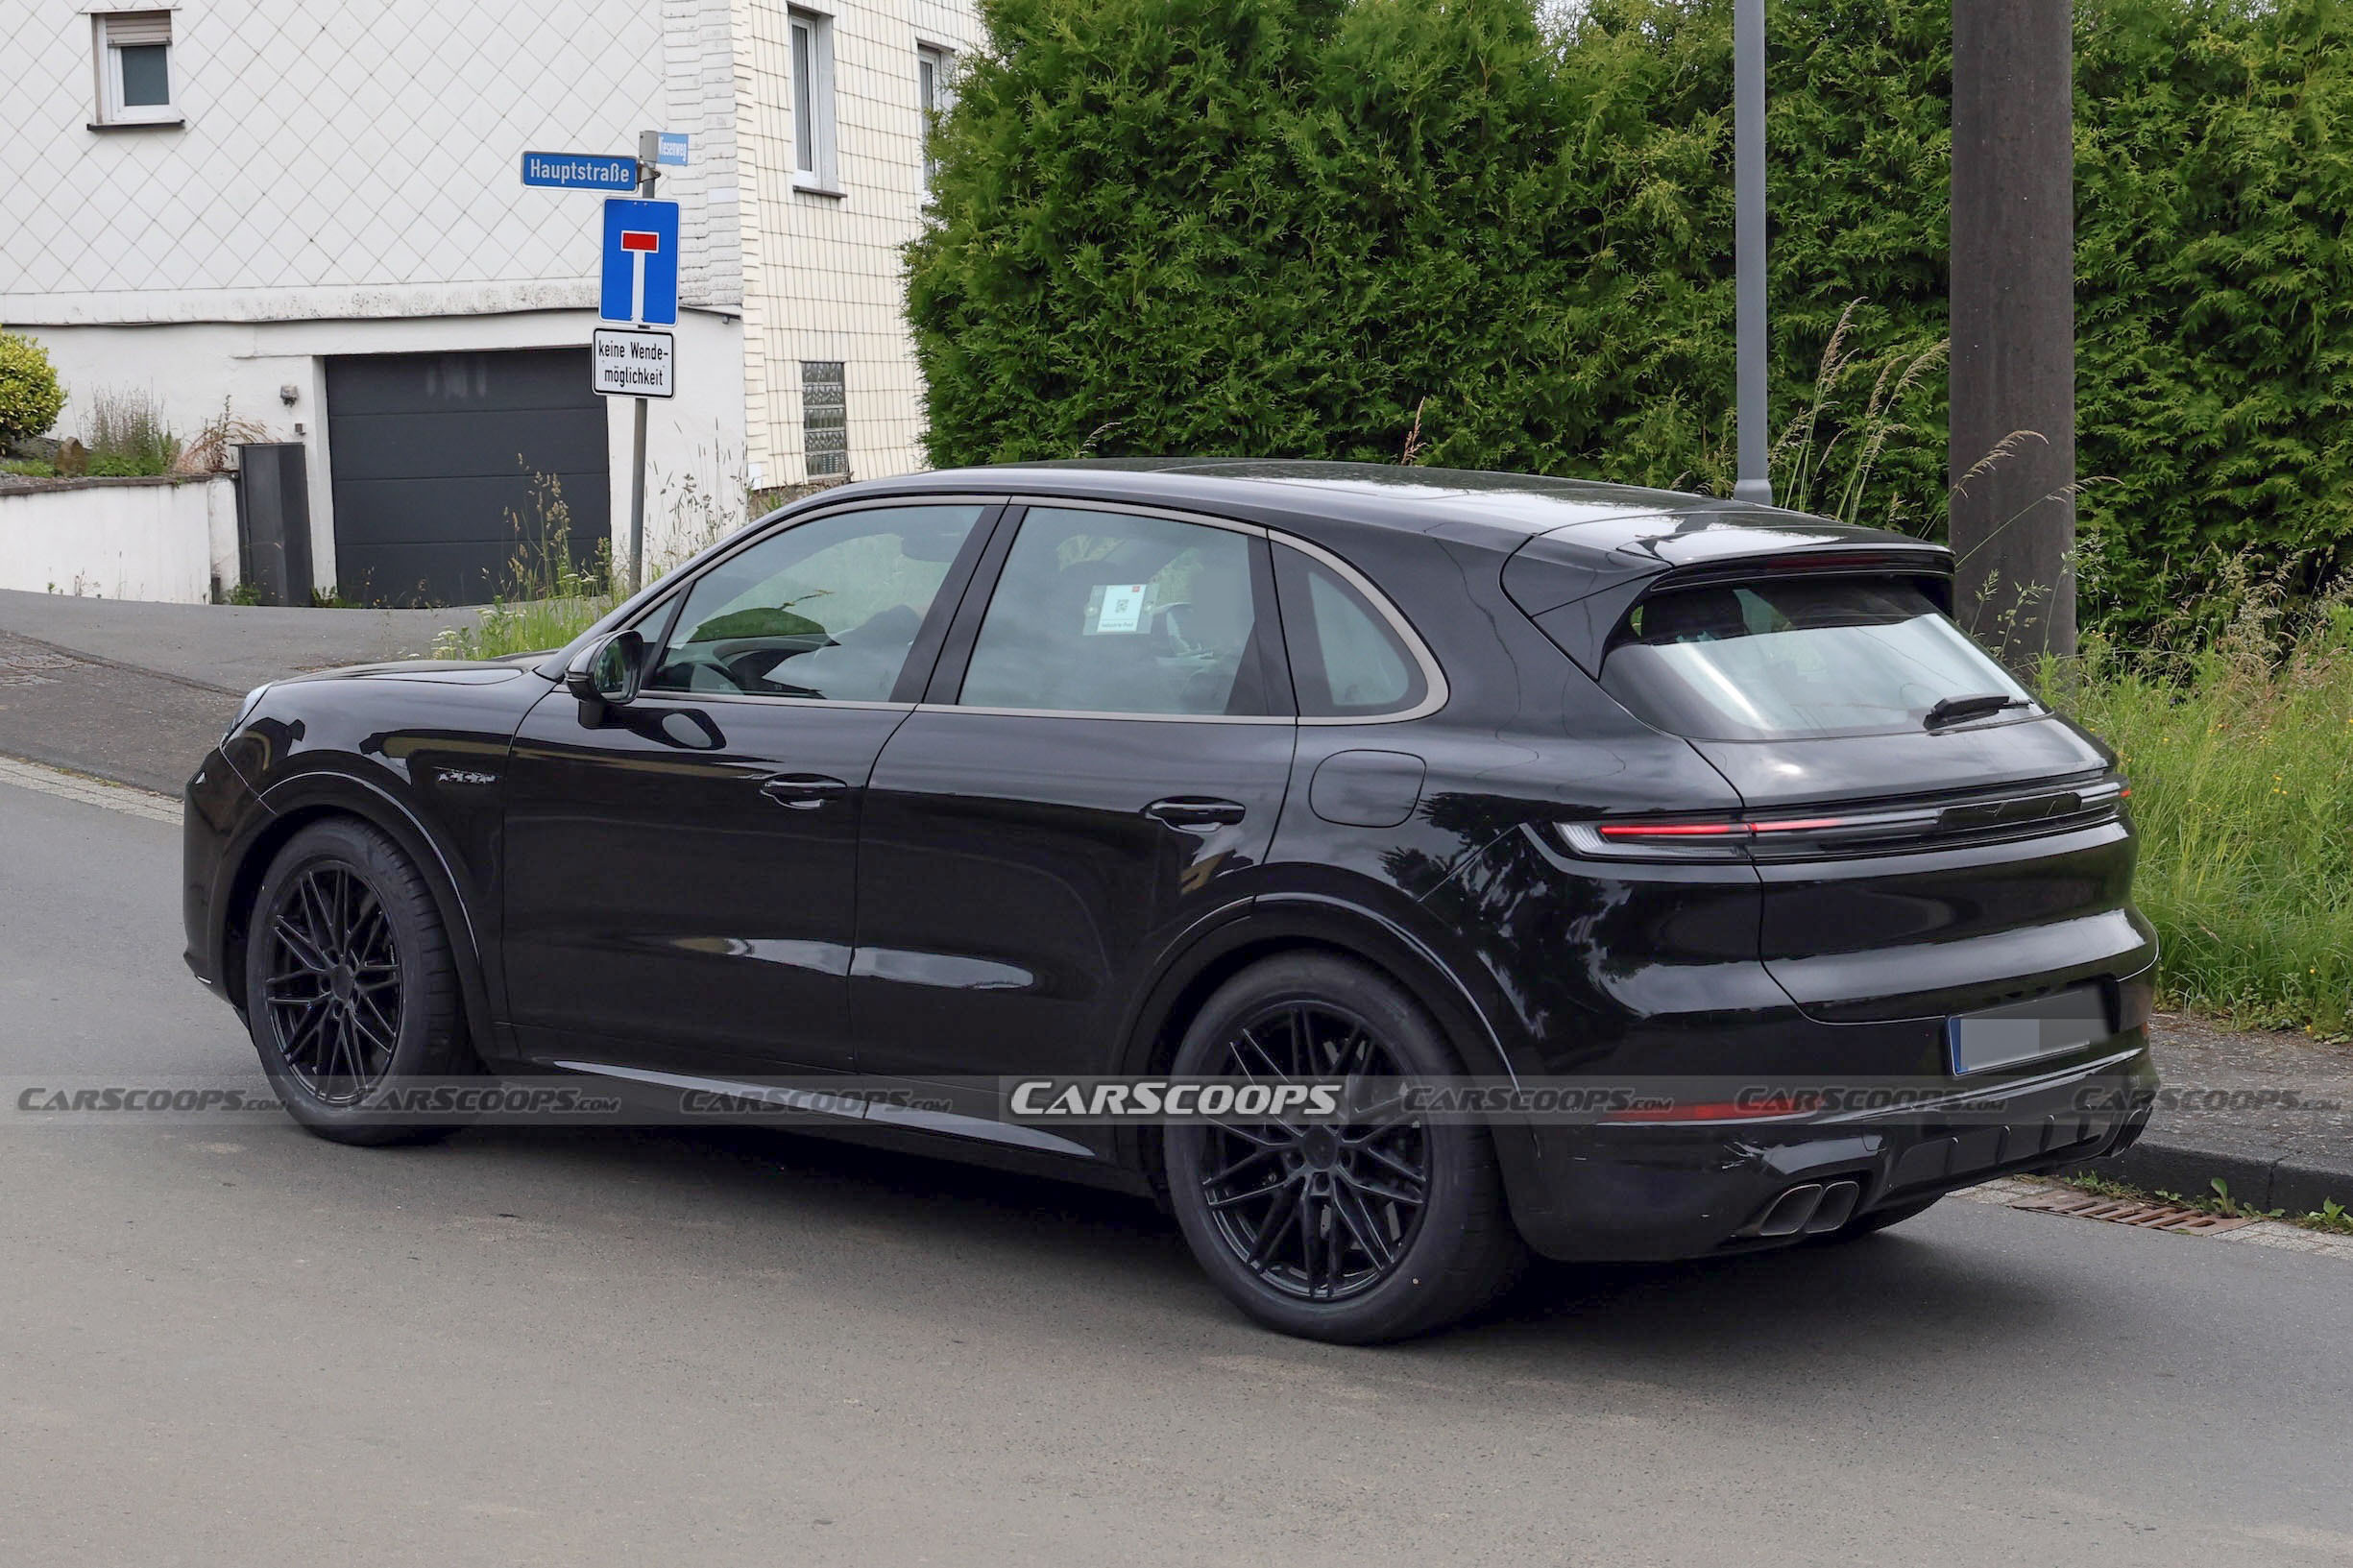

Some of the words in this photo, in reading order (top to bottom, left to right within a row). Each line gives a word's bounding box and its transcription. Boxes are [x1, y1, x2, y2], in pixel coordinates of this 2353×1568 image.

[530, 158, 630, 184] Hauptstraße
[598, 339, 625, 358] keine
[630, 341, 669, 360] Wende-
[604, 365, 663, 388] möglichkeit
